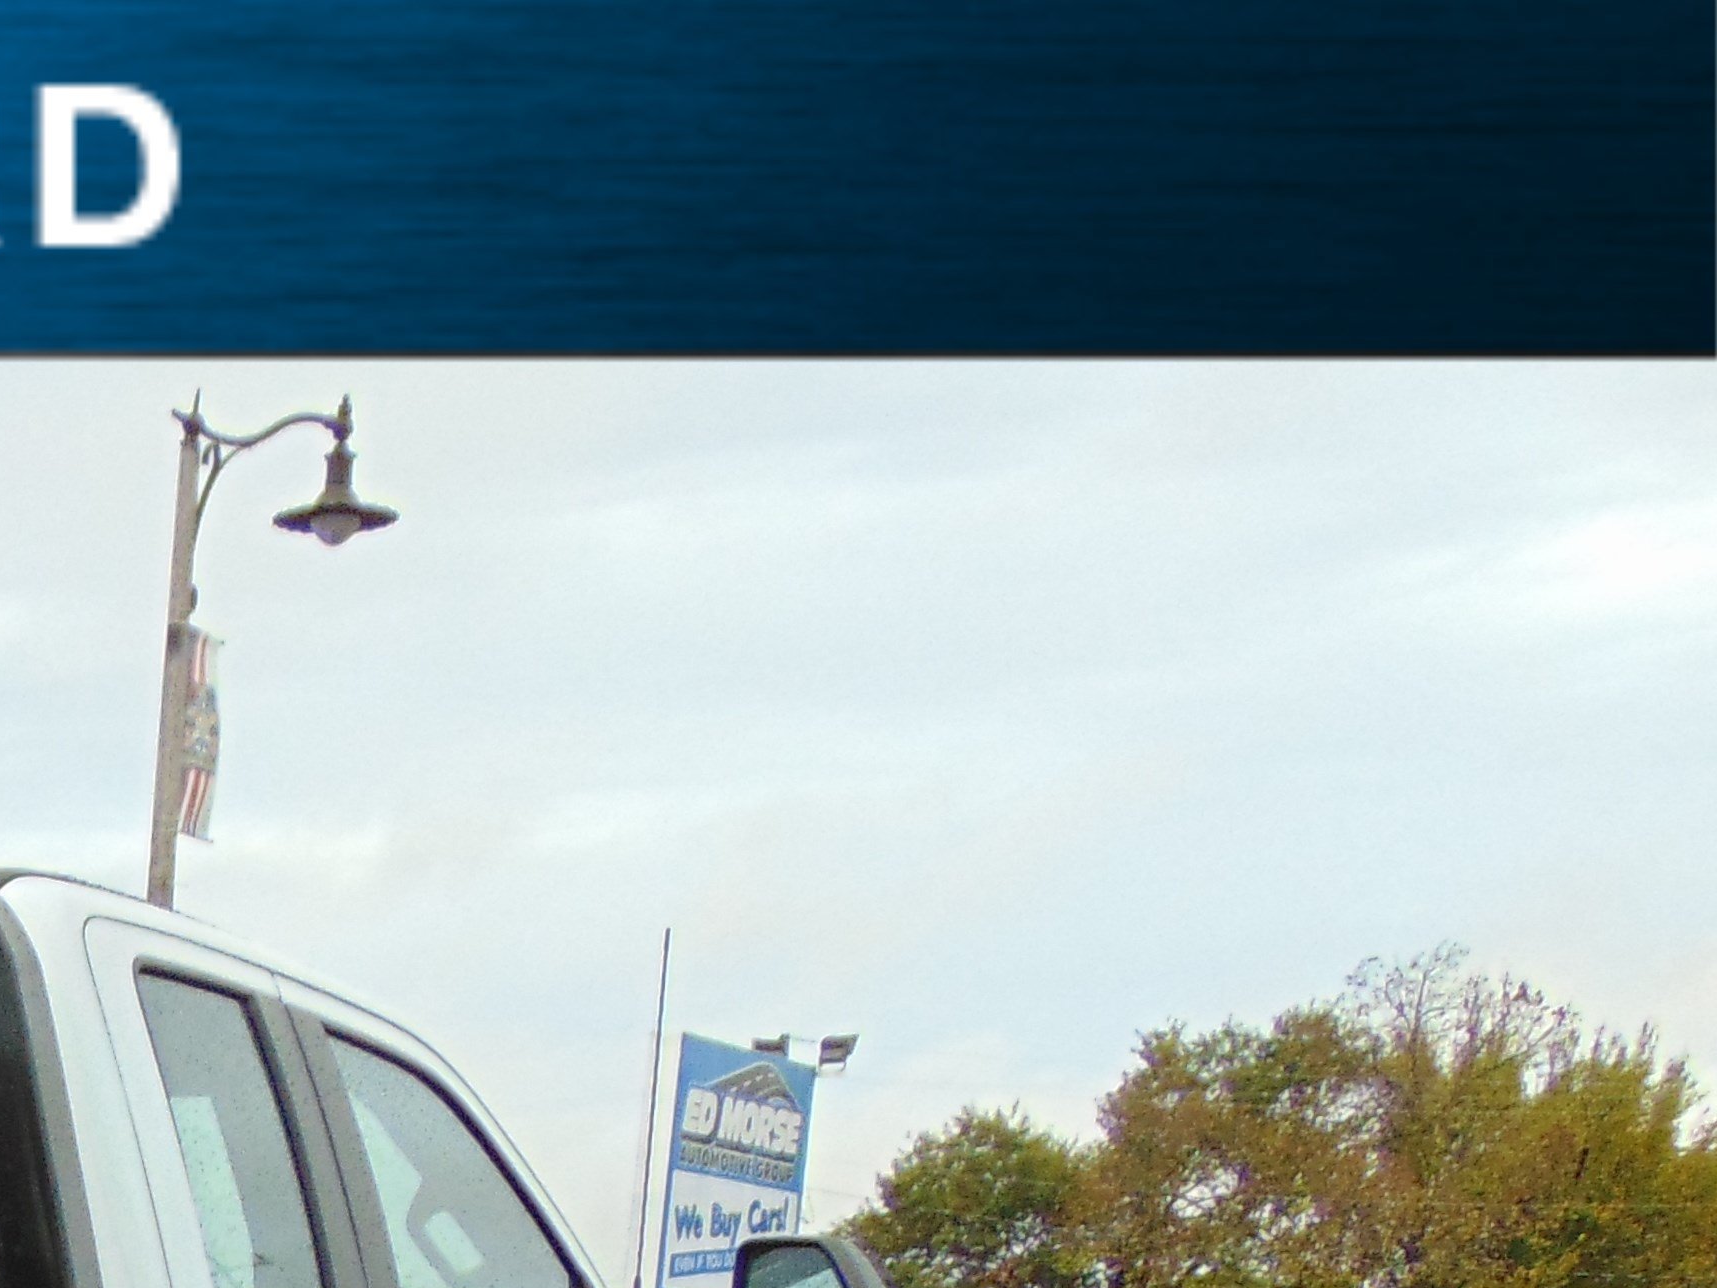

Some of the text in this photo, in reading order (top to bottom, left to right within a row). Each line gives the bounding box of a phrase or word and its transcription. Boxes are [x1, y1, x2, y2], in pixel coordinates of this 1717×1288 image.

[682, 1088, 803, 1154] ED MORSE
[674, 1195, 790, 1248] We Buy Cars!
